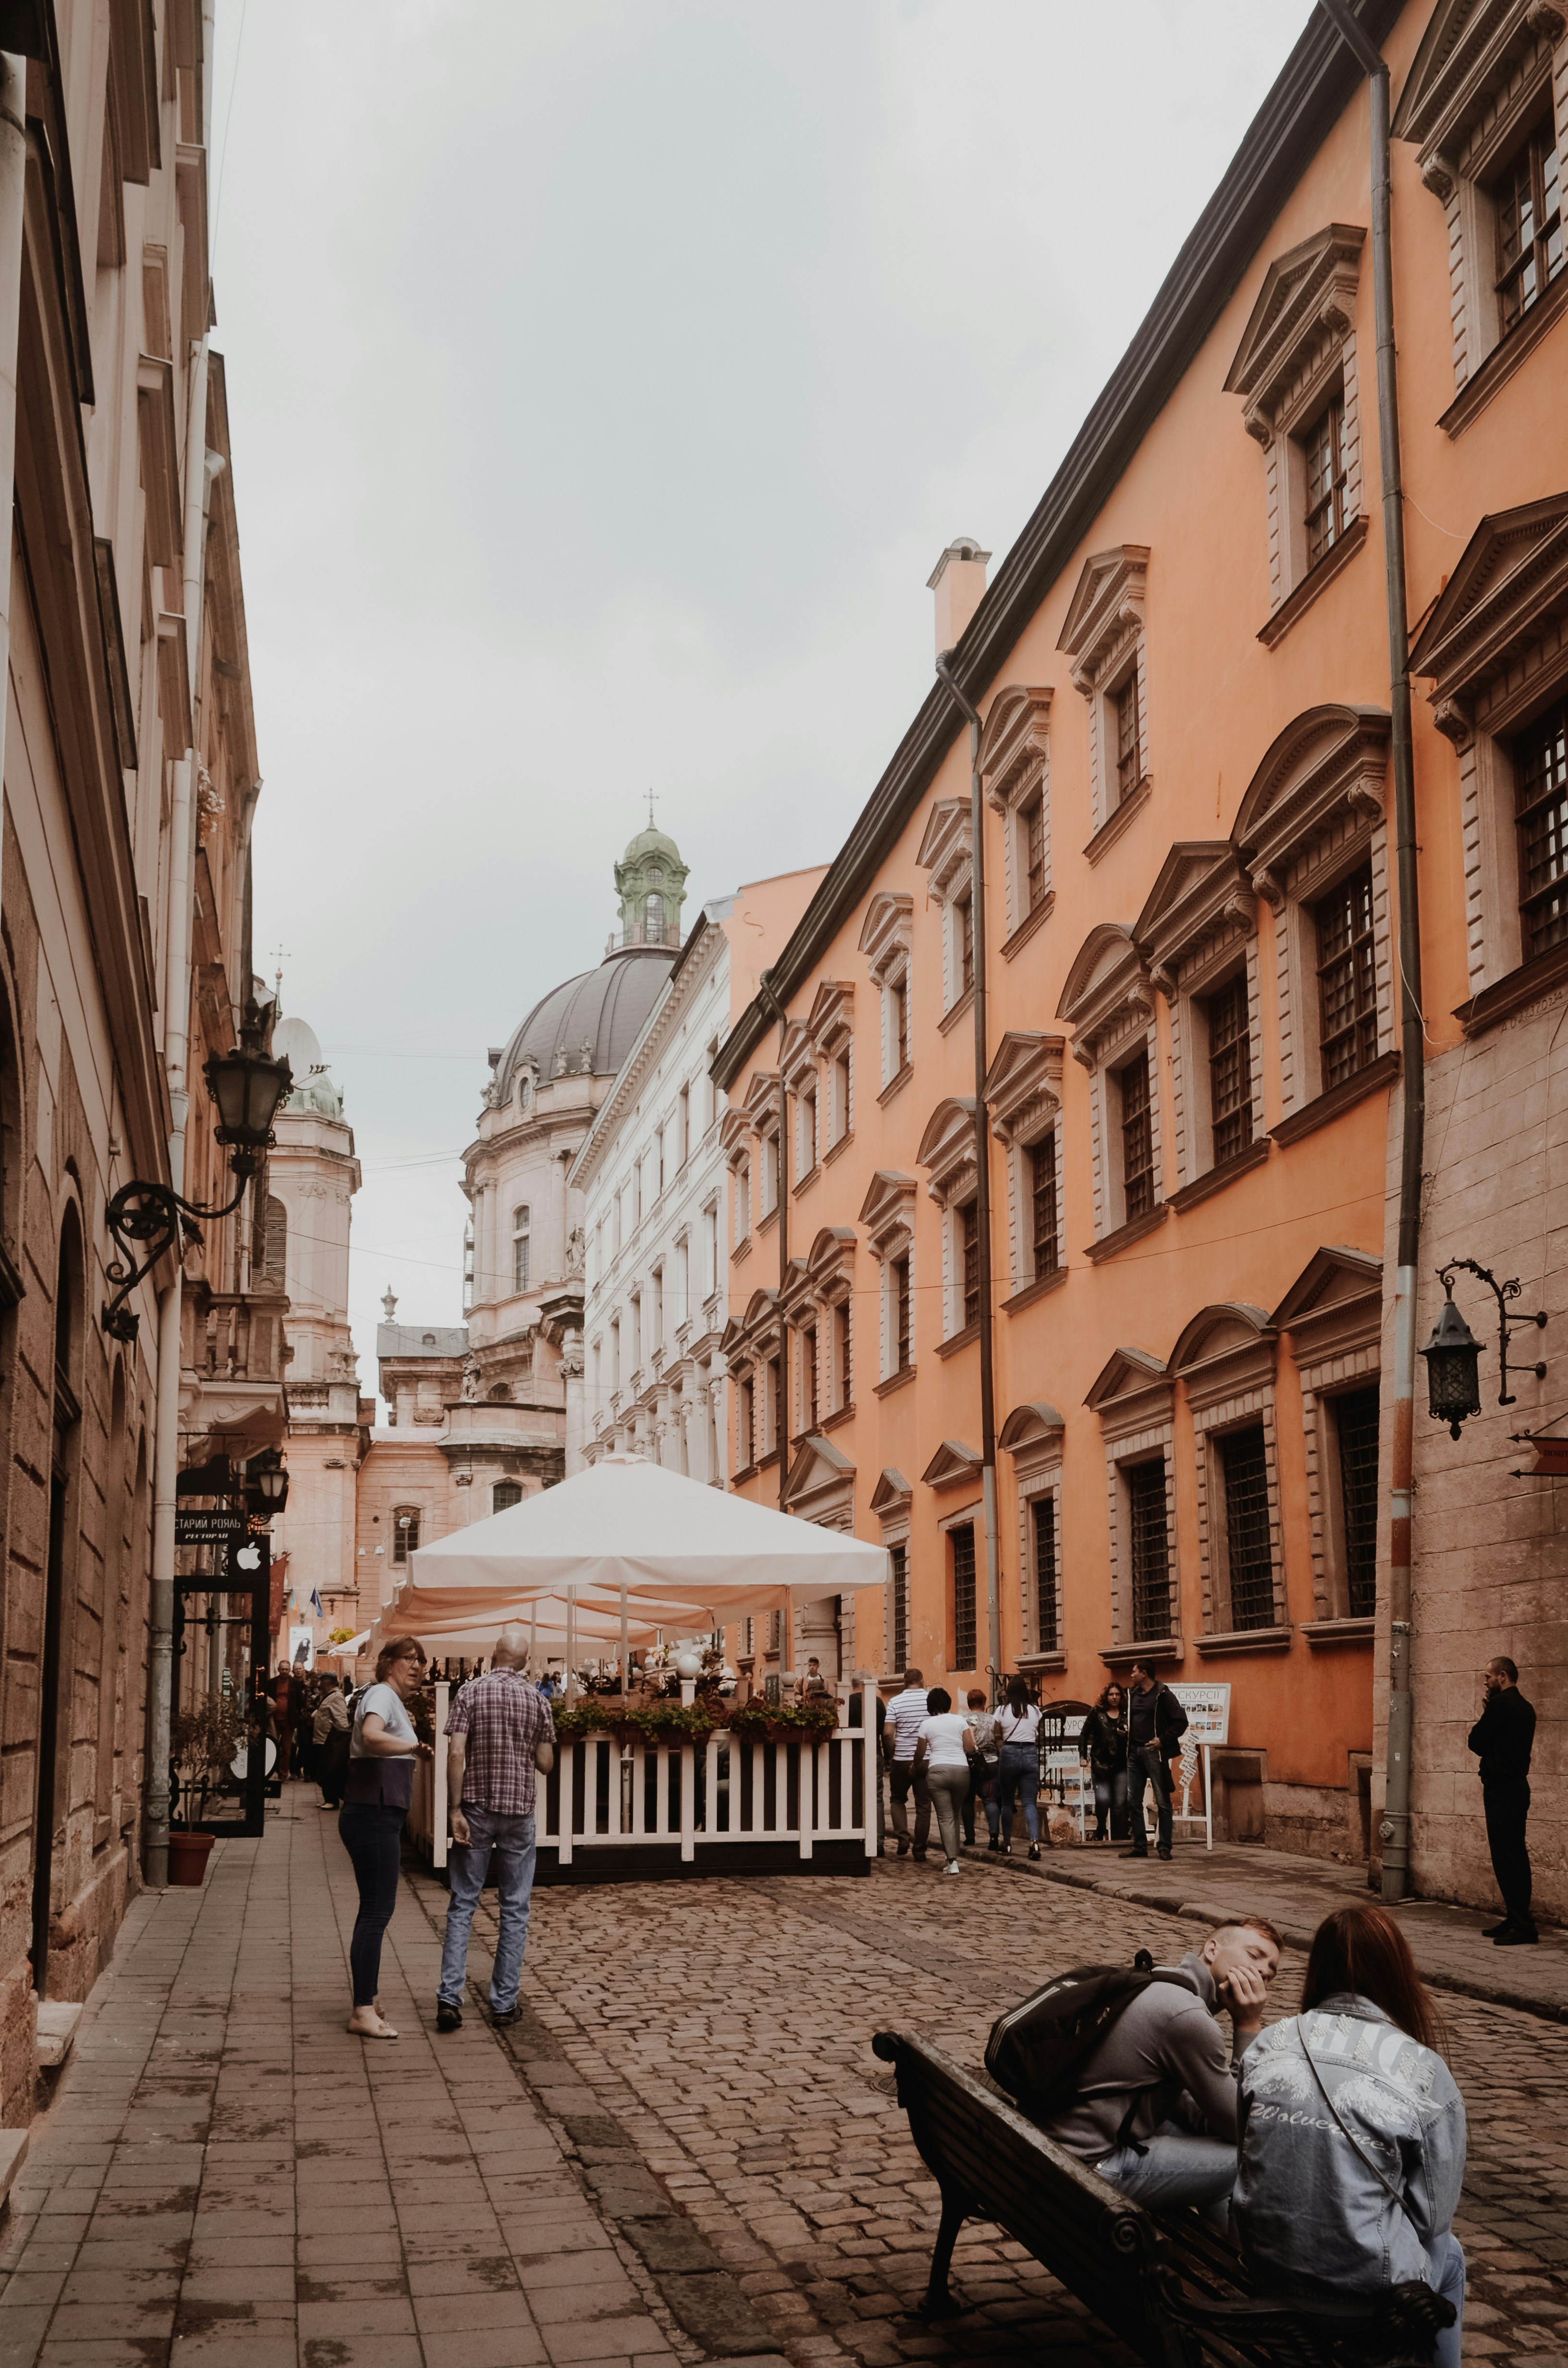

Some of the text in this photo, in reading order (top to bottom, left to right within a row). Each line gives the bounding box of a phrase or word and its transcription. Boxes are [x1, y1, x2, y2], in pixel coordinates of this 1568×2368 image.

[175, 1516, 241, 1529] СТАРИЙ РОЯЛЬ
[1173, 1689, 1220, 1699] СКУРСІЇ
